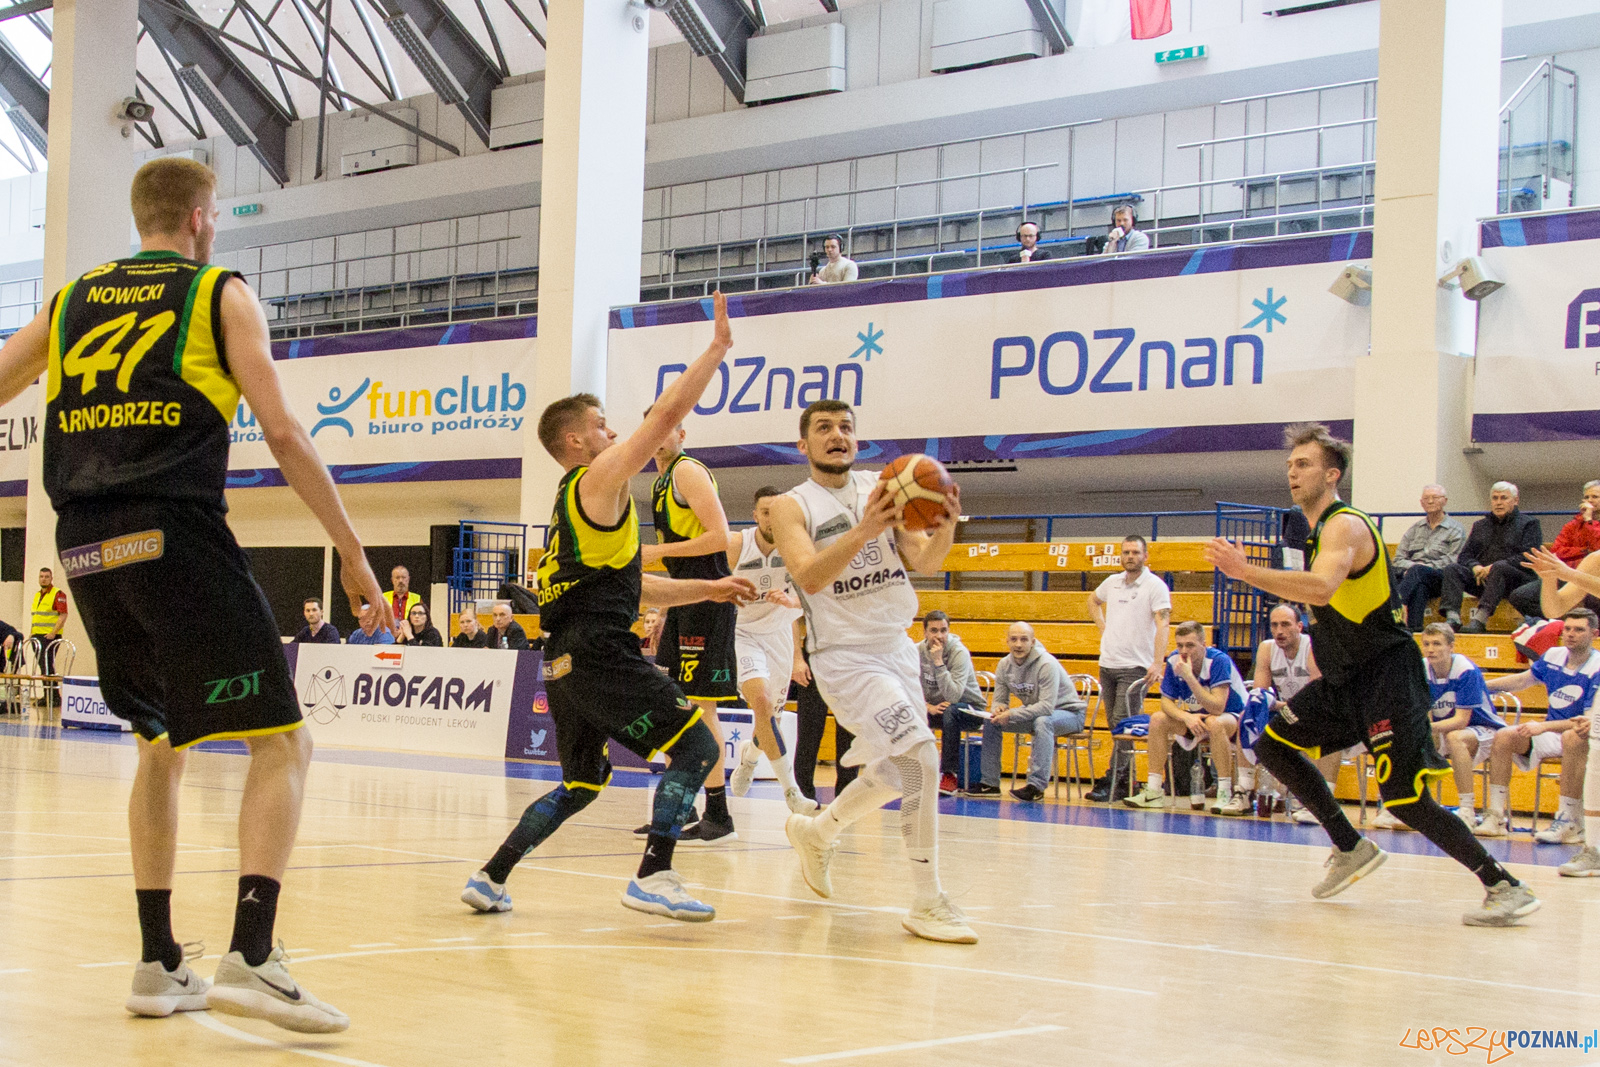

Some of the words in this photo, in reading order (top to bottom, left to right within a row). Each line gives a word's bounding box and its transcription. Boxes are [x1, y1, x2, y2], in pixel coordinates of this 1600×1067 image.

[86, 283, 165, 304] NOWICKI
[63, 309, 176, 395] 41
[367, 372, 527, 420] funclub
[368, 420, 424, 435] biuro
[431, 414, 524, 435] podróży
[833, 568, 905, 594] BIOFARM
[1488, 649, 1497, 657] 11
[204, 669, 265, 704] ZOT
[352, 673, 494, 713] BIOFARM
[361, 713, 391, 723] POLSKI
[447, 717, 477, 729] LEKÓW
[524, 747, 548, 756] twitter
